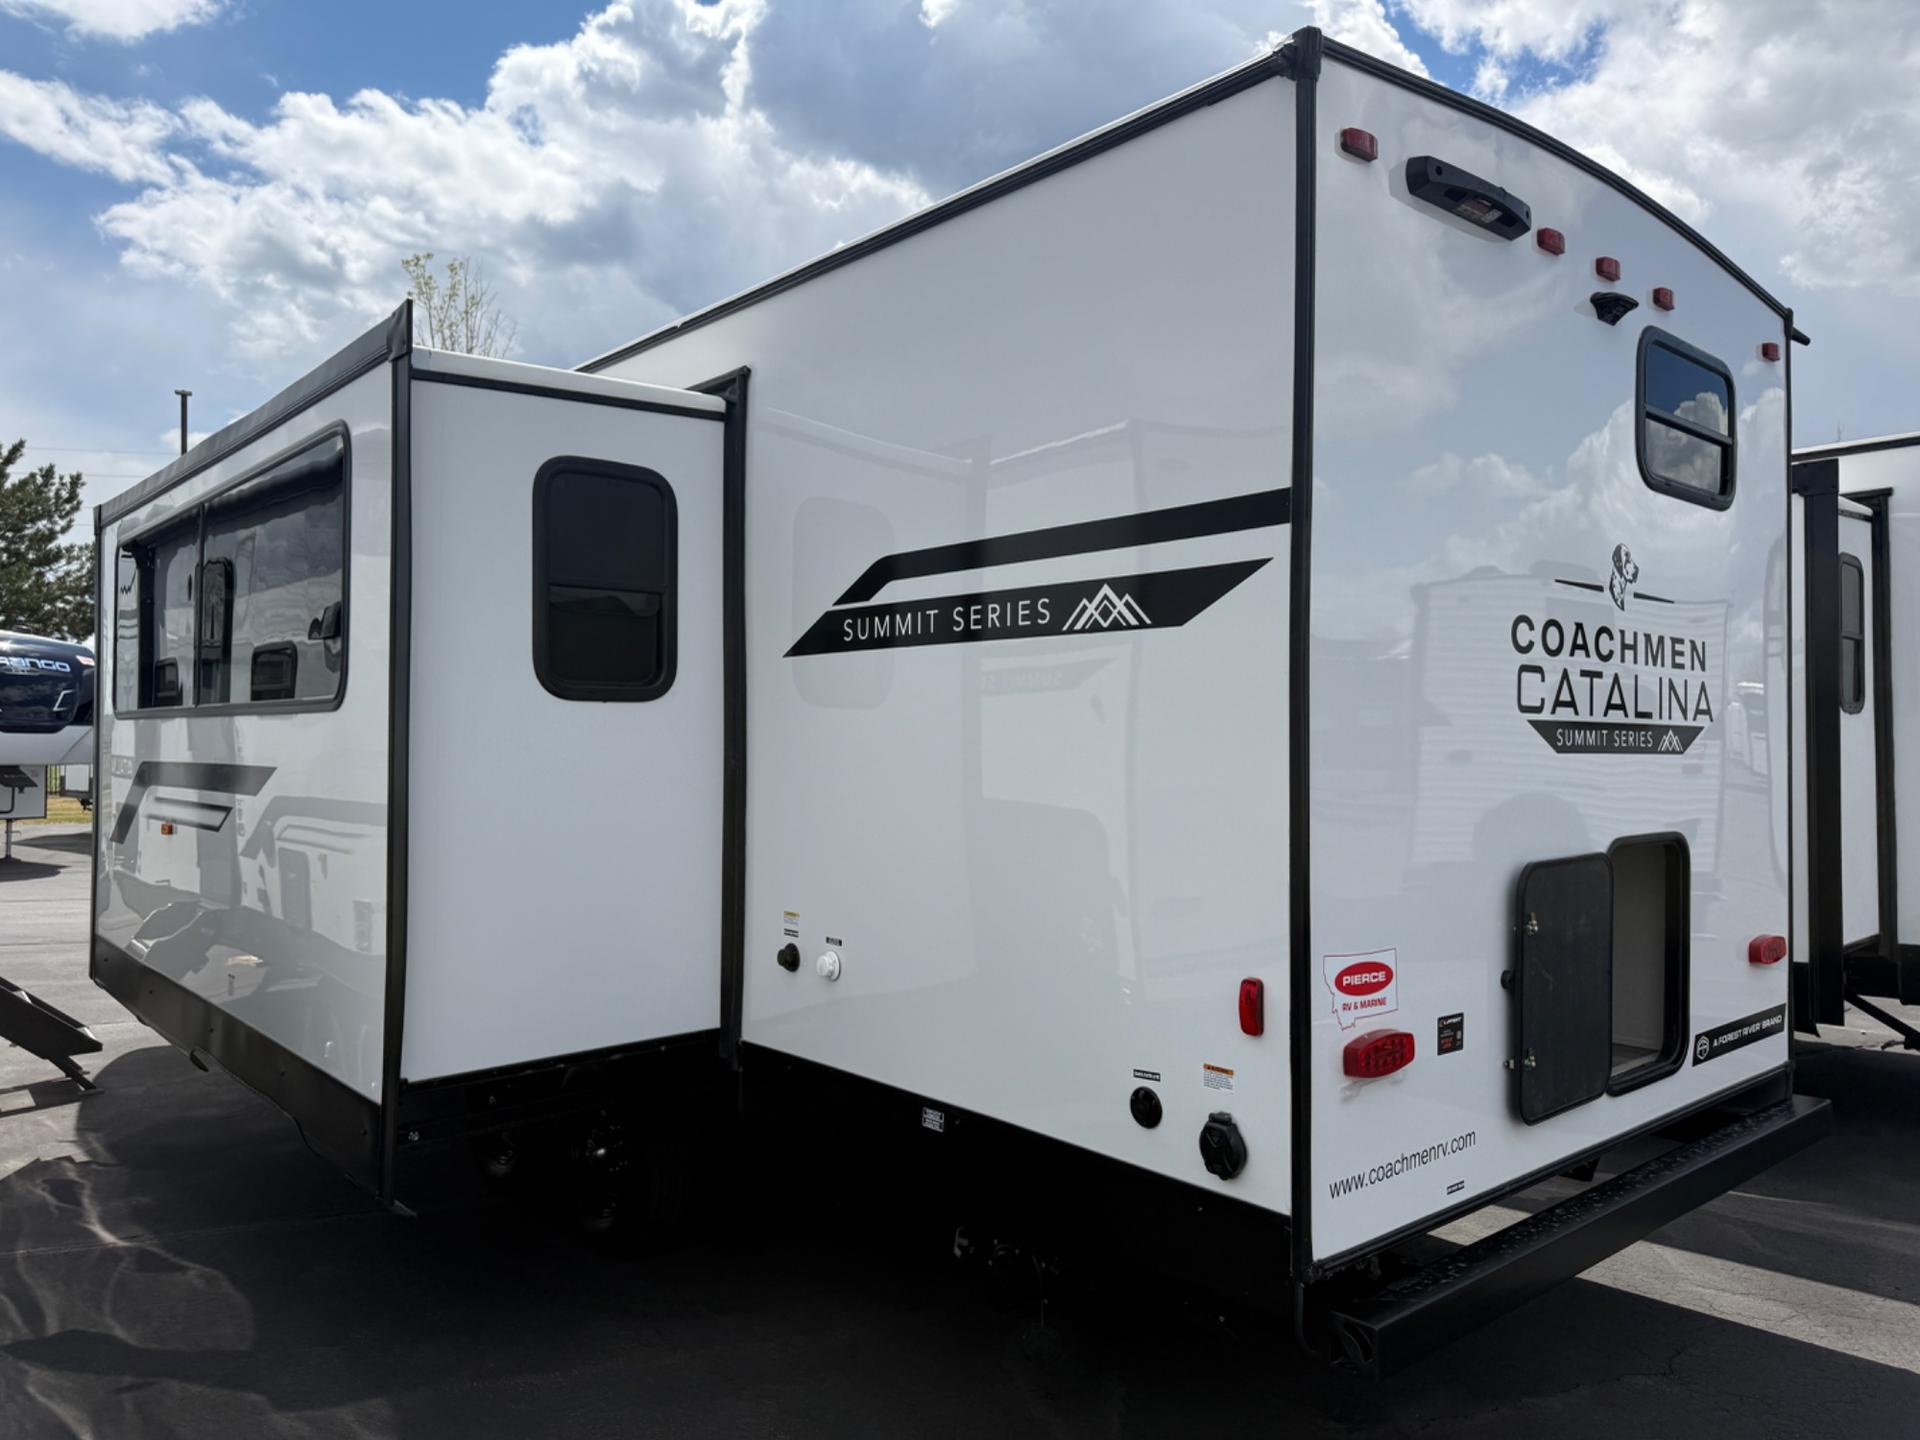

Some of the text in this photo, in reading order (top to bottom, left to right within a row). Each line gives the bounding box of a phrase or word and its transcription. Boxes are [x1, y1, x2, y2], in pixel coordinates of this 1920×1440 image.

[843, 598, 1051, 641] SUMMIT SERIES
[1511, 614, 1706, 672] COACHMEN
[1516, 664, 1714, 722] CATALINA
[1556, 728, 1653, 748] SUMMIT SERIES
[1343, 971, 1387, 986] PIERCE
[1342, 1002, 1352, 1011] RV
[1360, 997, 1387, 1009] MARINE
[1719, 1029, 1742, 1045] FOREST
[1762, 1015, 1782, 1029] BRAND
[1329, 1130, 1476, 1199] www.coachmenrv.com
